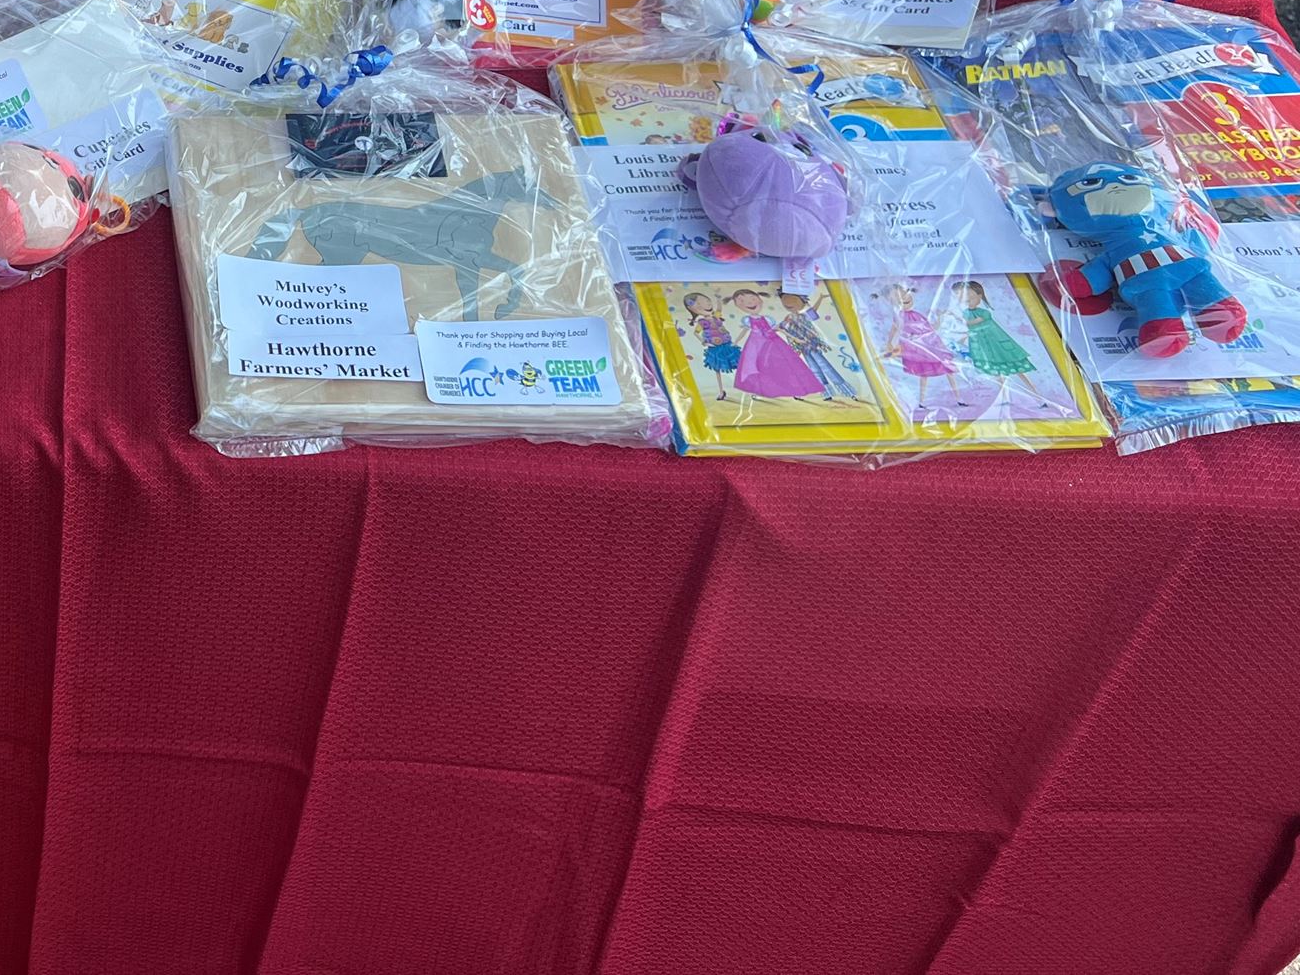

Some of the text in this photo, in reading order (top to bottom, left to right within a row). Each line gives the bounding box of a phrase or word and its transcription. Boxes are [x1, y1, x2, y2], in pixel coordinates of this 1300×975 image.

[172, 42, 244, 74] Supplies
[966, 60, 1066, 84] BATMAN
[1205, 93, 1239, 124] 3
[275, 279, 346, 297] Mulvey's
[257, 294, 369, 312] Woodworking
[276, 313, 352, 326] Creations
[437, 331, 459, 339] Thank
[461, 333, 474, 341] you
[490, 331, 523, 341] Shopping
[541, 330, 565, 341] Buying
[568, 329, 588, 337] Local
[267, 342, 376, 357] Hawthorne
[465, 340, 490, 350] Finding
[550, 340, 568, 348] BEE.
[240, 359, 410, 378] Farmers' Market
[546, 360, 594, 377] GREEN
[462, 377, 496, 397] HCC
[549, 376, 599, 392] TEAM
